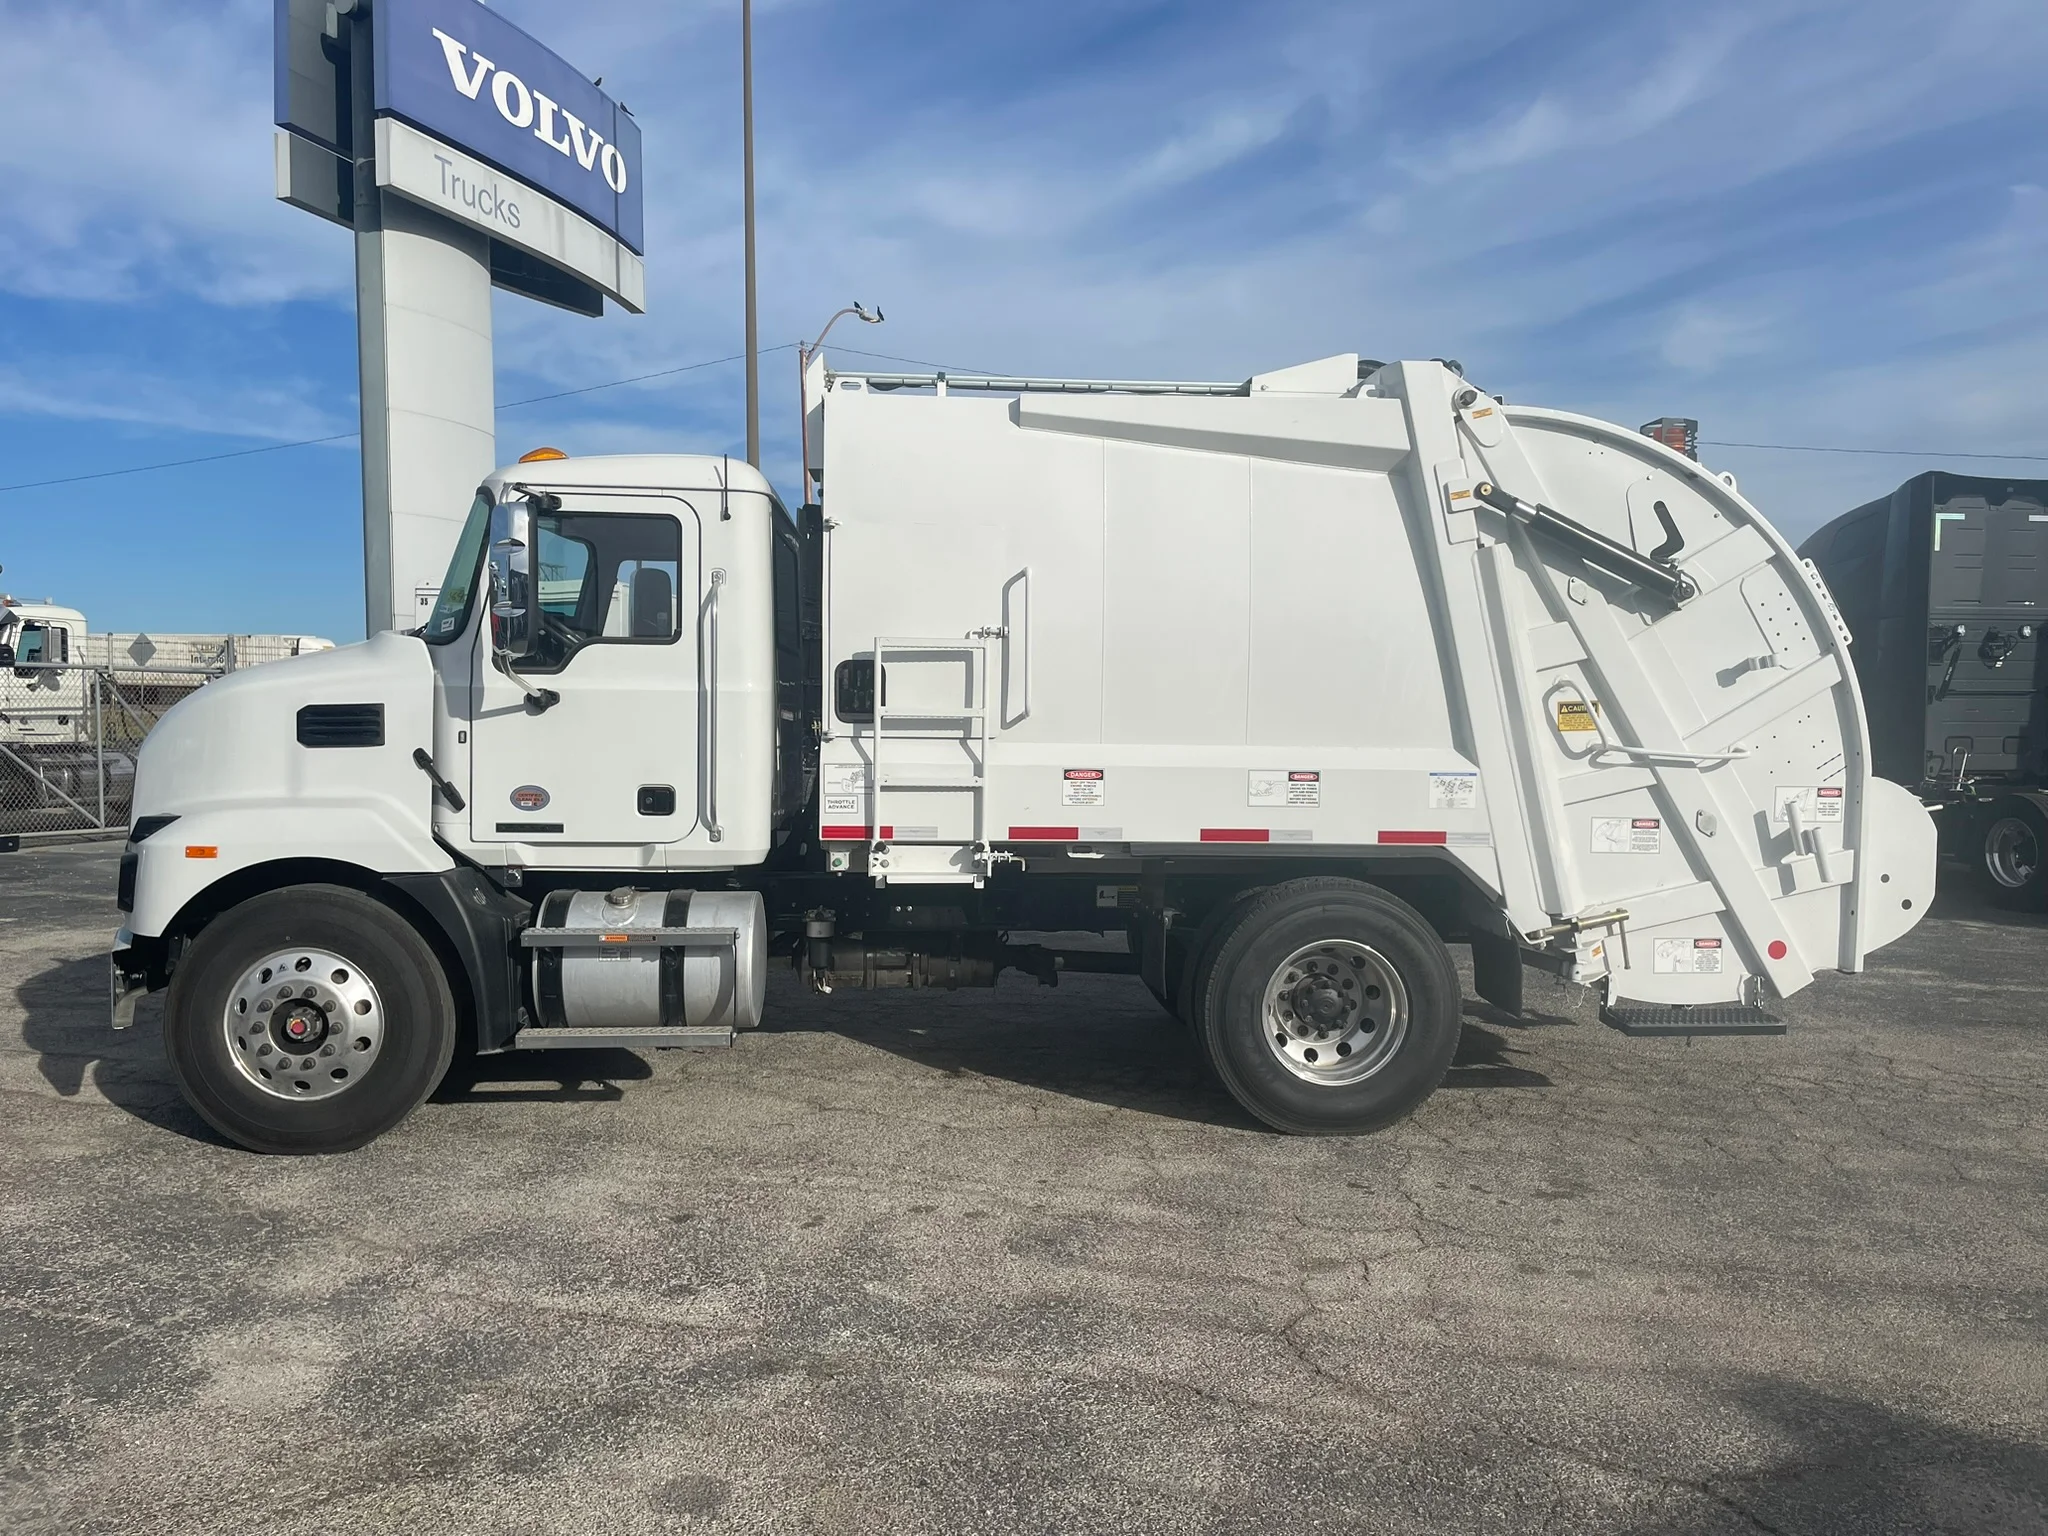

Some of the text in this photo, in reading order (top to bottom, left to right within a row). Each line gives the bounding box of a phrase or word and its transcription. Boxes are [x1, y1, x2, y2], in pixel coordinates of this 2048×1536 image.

[431, 27, 627, 195] VOLVO
[434, 153, 521, 229] Trucks
[420, 597, 428, 606] 35
